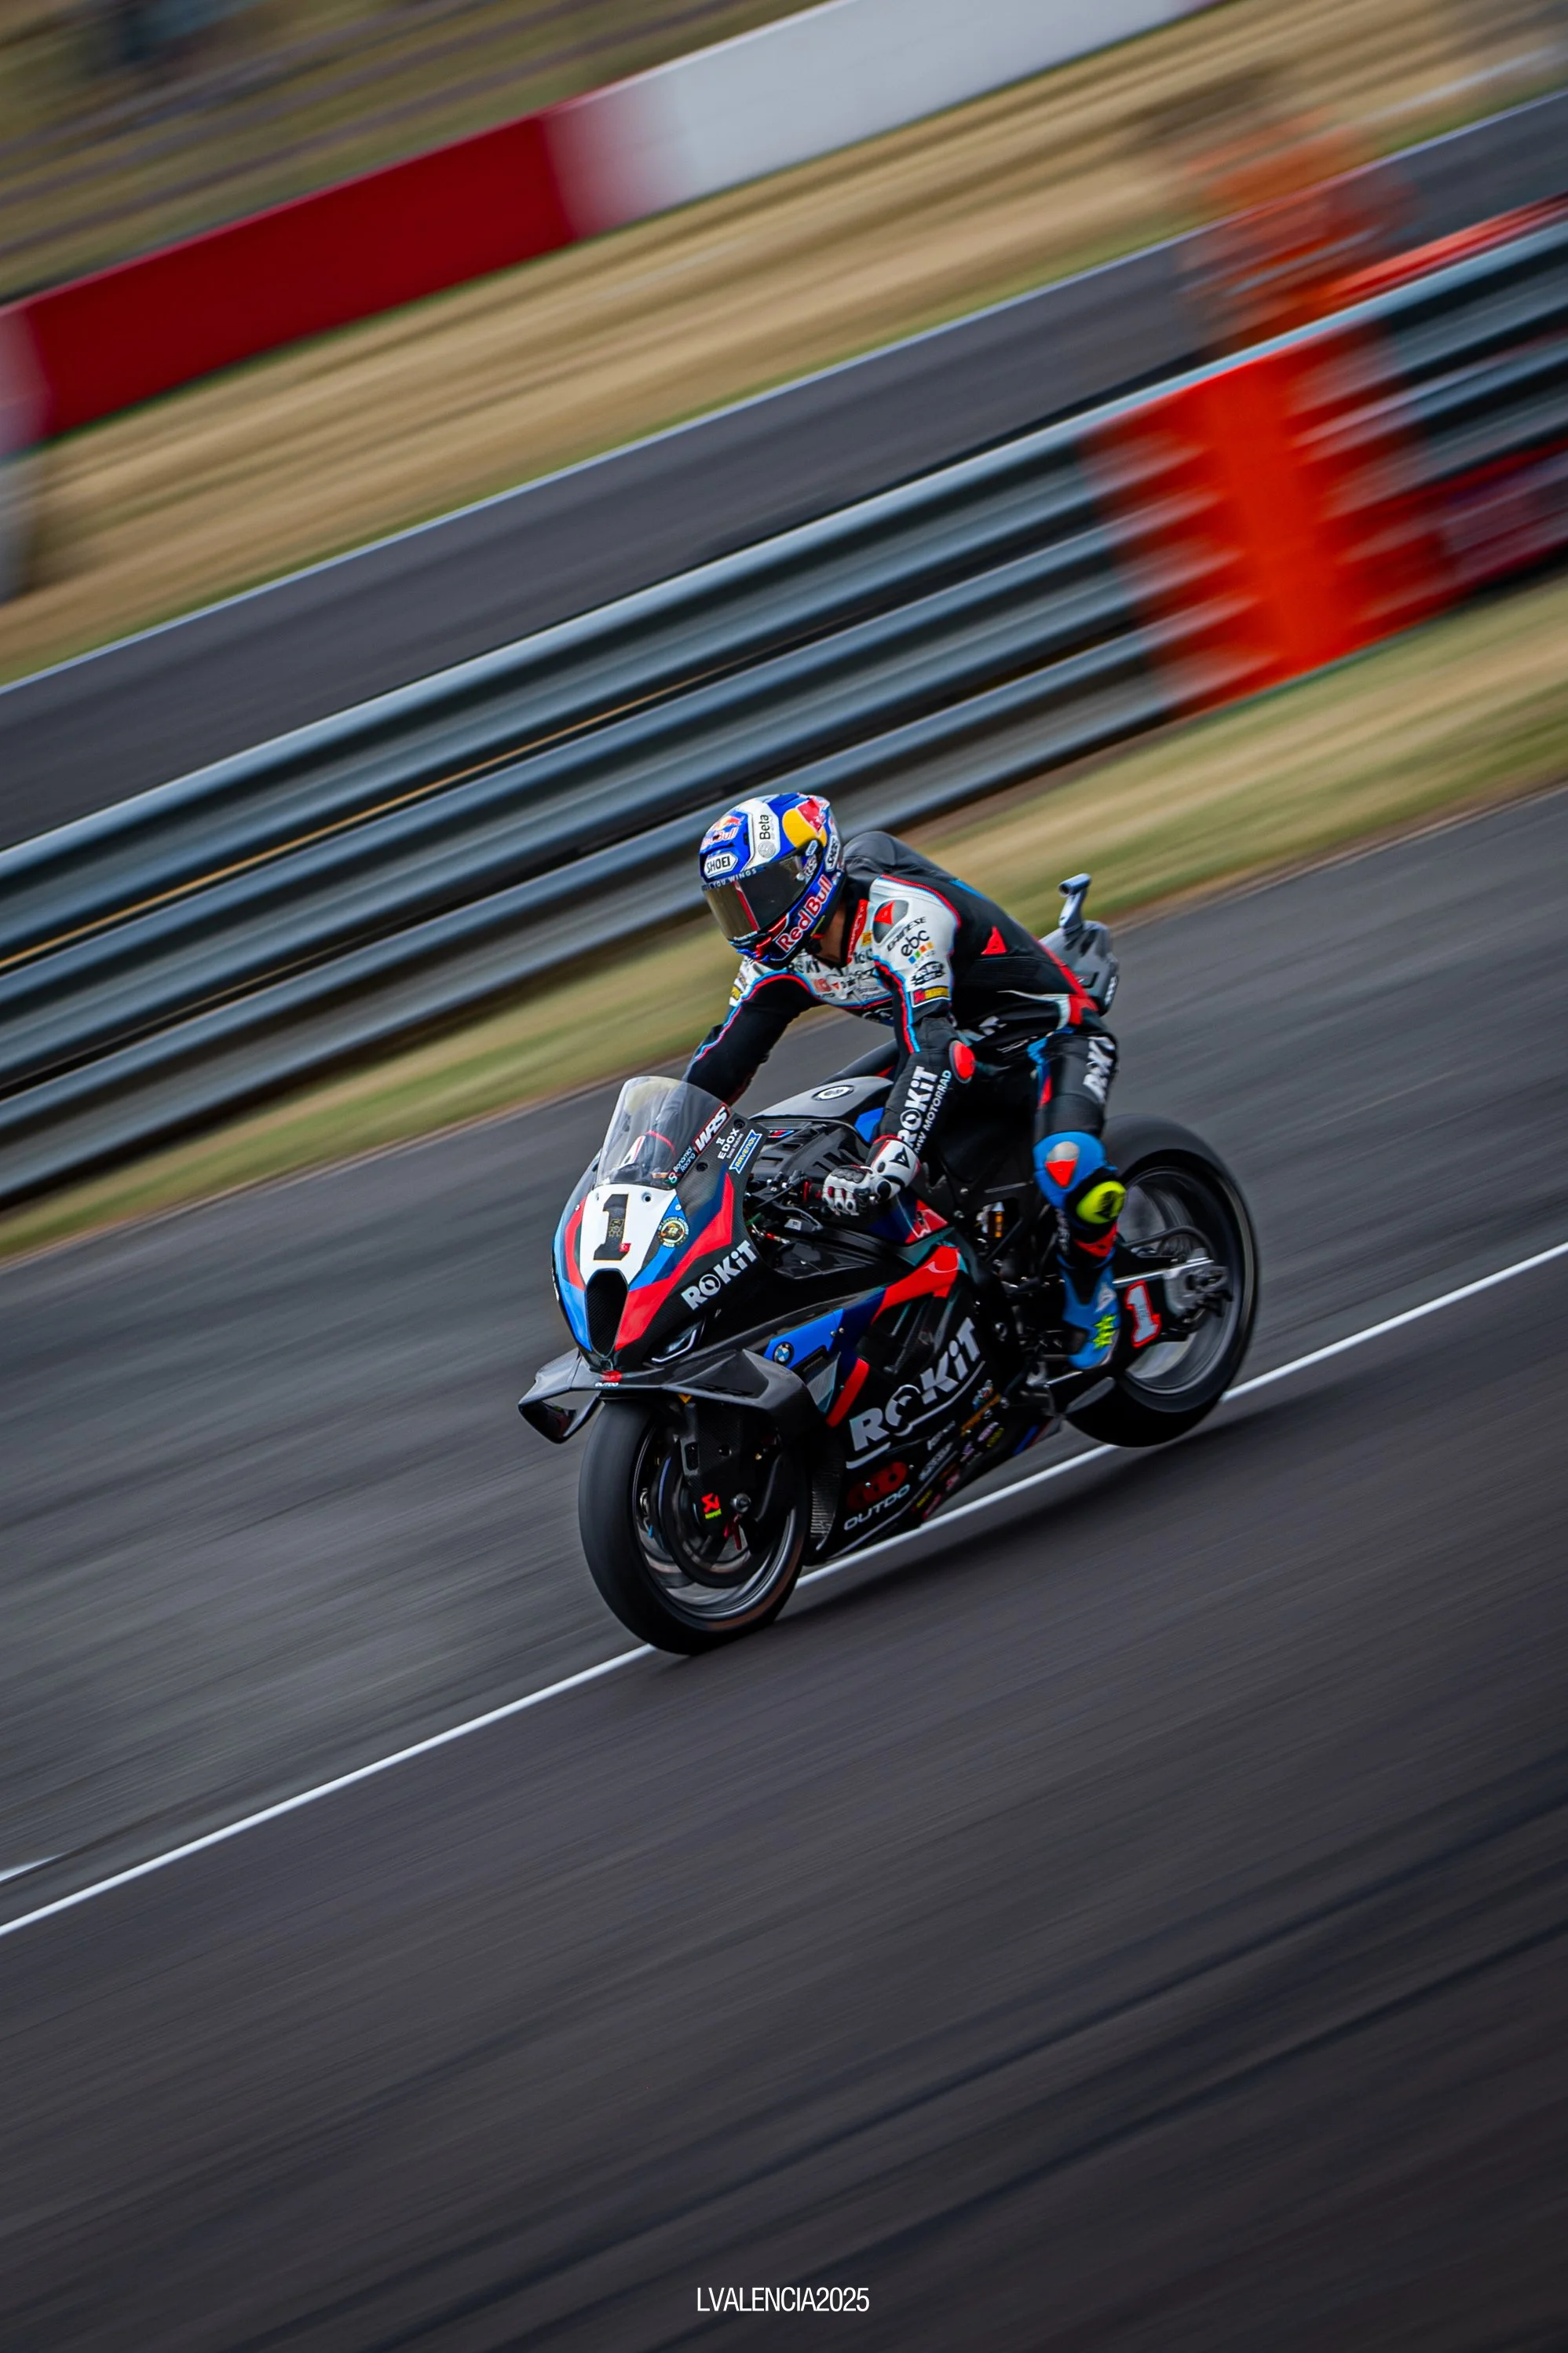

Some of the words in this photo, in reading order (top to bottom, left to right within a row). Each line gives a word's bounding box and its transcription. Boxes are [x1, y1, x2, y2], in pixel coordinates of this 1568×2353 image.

[759, 814, 771, 840] Beta
[706, 855, 731, 874] SHOEI
[728, 867, 757, 884] WINGS
[776, 909, 813, 953] Red
[805, 874, 834, 918] Bull
[901, 929, 930, 957] ebc
[694, 1105, 728, 1151] WRS
[914, 1131, 927, 1154] MW
[923, 1070, 952, 1132] MOTORRAD
[717, 1128, 740, 1160] EDOX
[593, 1193, 629, 1261] 1
[681, 1240, 759, 1310] ROKiT
[1124, 1280, 1162, 1348] 1
[848, 1316, 981, 1453] ROKiT
[843, 1484, 911, 1531] OUTDO
